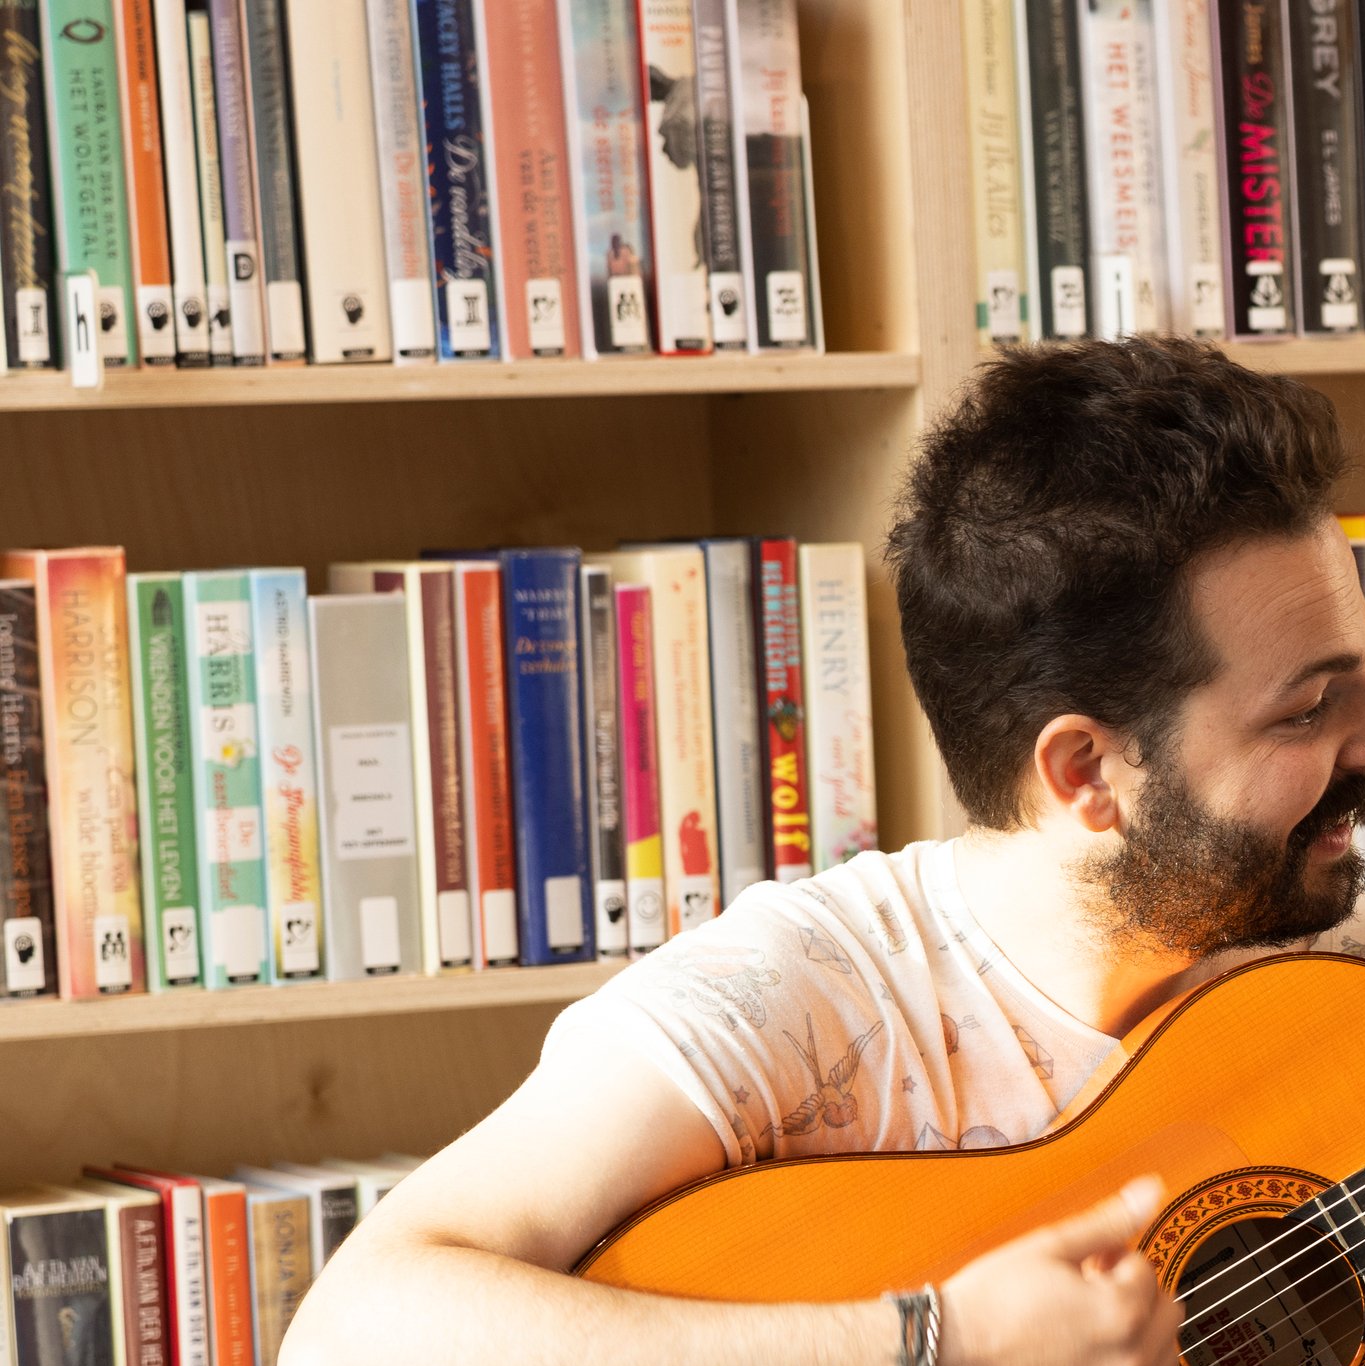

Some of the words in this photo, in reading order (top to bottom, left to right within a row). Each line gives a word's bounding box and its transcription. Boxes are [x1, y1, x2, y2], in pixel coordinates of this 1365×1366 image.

[1106, 43, 1129, 90] HET
[1311, 0, 1341, 100] GREY
[68, 69, 88, 116] HET
[442, 63, 465, 130] HALLS
[72, 124, 97, 261] WOLFGETAL
[1110, 106, 1138, 250] WEESMEIS
[61, 590, 99, 747] HARRISON
[816, 579, 847, 698] HENRY
[148, 633, 170, 730] VRIENDEN
[205, 614, 237, 734] HARRIS
[153, 735, 175, 794] VOOR
[77, 788, 98, 846] wilde
[156, 799, 177, 835] HET
[771, 752, 809, 852] wolf
[107, 818, 128, 854] pad
[237, 820, 256, 848] De
[159, 840, 183, 901] LEVEN
[274, 1209, 297, 1281] SONJA
[139, 1307, 163, 1340] DER
[188, 1280, 205, 1310] VAN
[188, 1315, 206, 1347] DER
